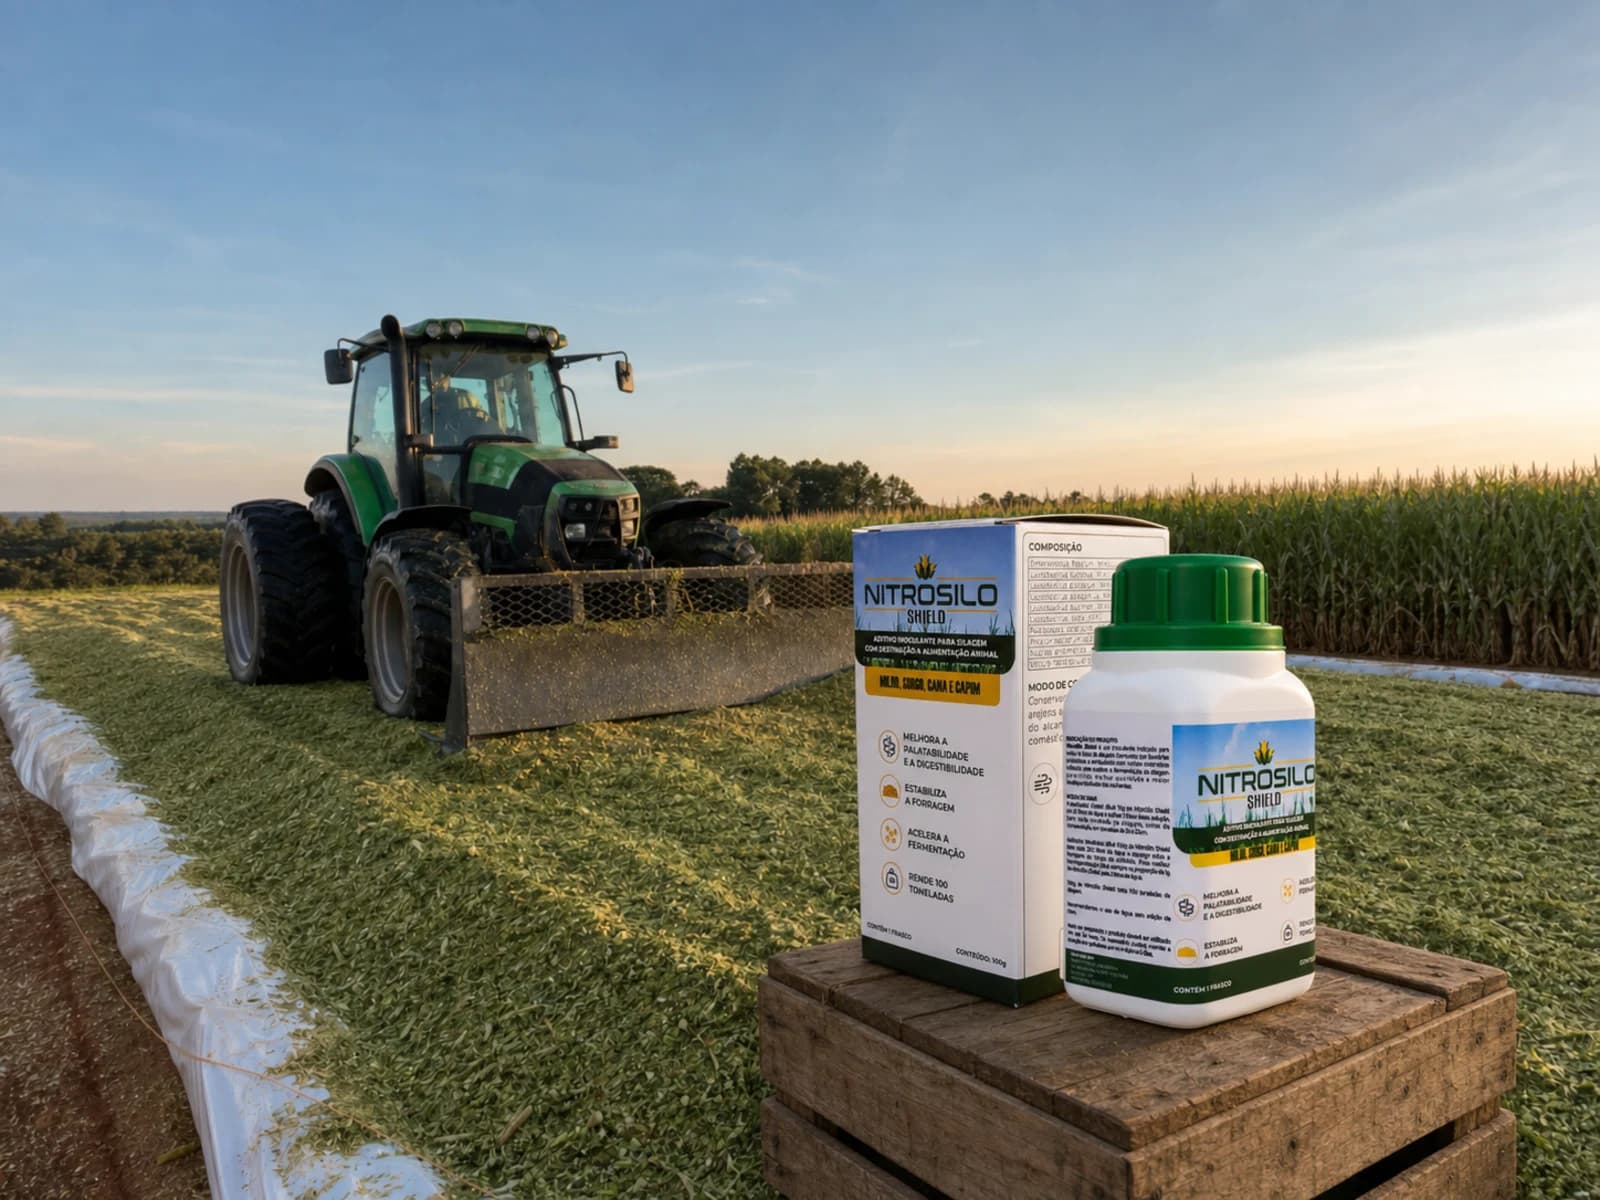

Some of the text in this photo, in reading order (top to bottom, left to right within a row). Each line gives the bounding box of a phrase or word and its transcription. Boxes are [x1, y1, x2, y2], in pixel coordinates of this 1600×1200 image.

[1028, 541, 1082, 554] COMPOSIÇÃO
[864, 584, 998, 606] NITROSILO
[907, 609, 946, 624] SHIELD
[937, 638, 956, 646] PARA
[970, 650, 999, 658] ANIMAL
[927, 678, 948, 693] CANA
[949, 680, 955, 693] E
[955, 681, 981, 695] CAPIM
[1028, 681, 1055, 691] MODO
[1056, 680, 1067, 689] DE
[1028, 723, 1039, 732] do
[903, 732, 948, 745] MELHORA A
[903, 745, 969, 761] PALATABILIDADE
[903, 757, 985, 777] E A DIGESTIBILIDADE
[1198, 764, 1315, 796] NITROSILO
[904, 784, 947, 798] ESTABILIZA
[905, 797, 955, 813] A FORRAGEM
[1247, 791, 1281, 810] SHIELD
[908, 828, 949, 843] ACELERA A
[908, 840, 965, 859] FERMENTAÇÃO
[908, 872, 949, 889] RENDE 100
[908, 885, 954, 903] TONELADAS
[1203, 895, 1253, 910] PALATABILIDADE
[1209, 912, 1214, 920] A
[891, 929, 912, 940] FRASCO
[1204, 936, 1238, 949] ESTABILIZA
[956, 947, 991, 962] CONTEÚDO:
[1204, 951, 1210, 959] A
[1173, 985, 1205, 994] CONTÉM
